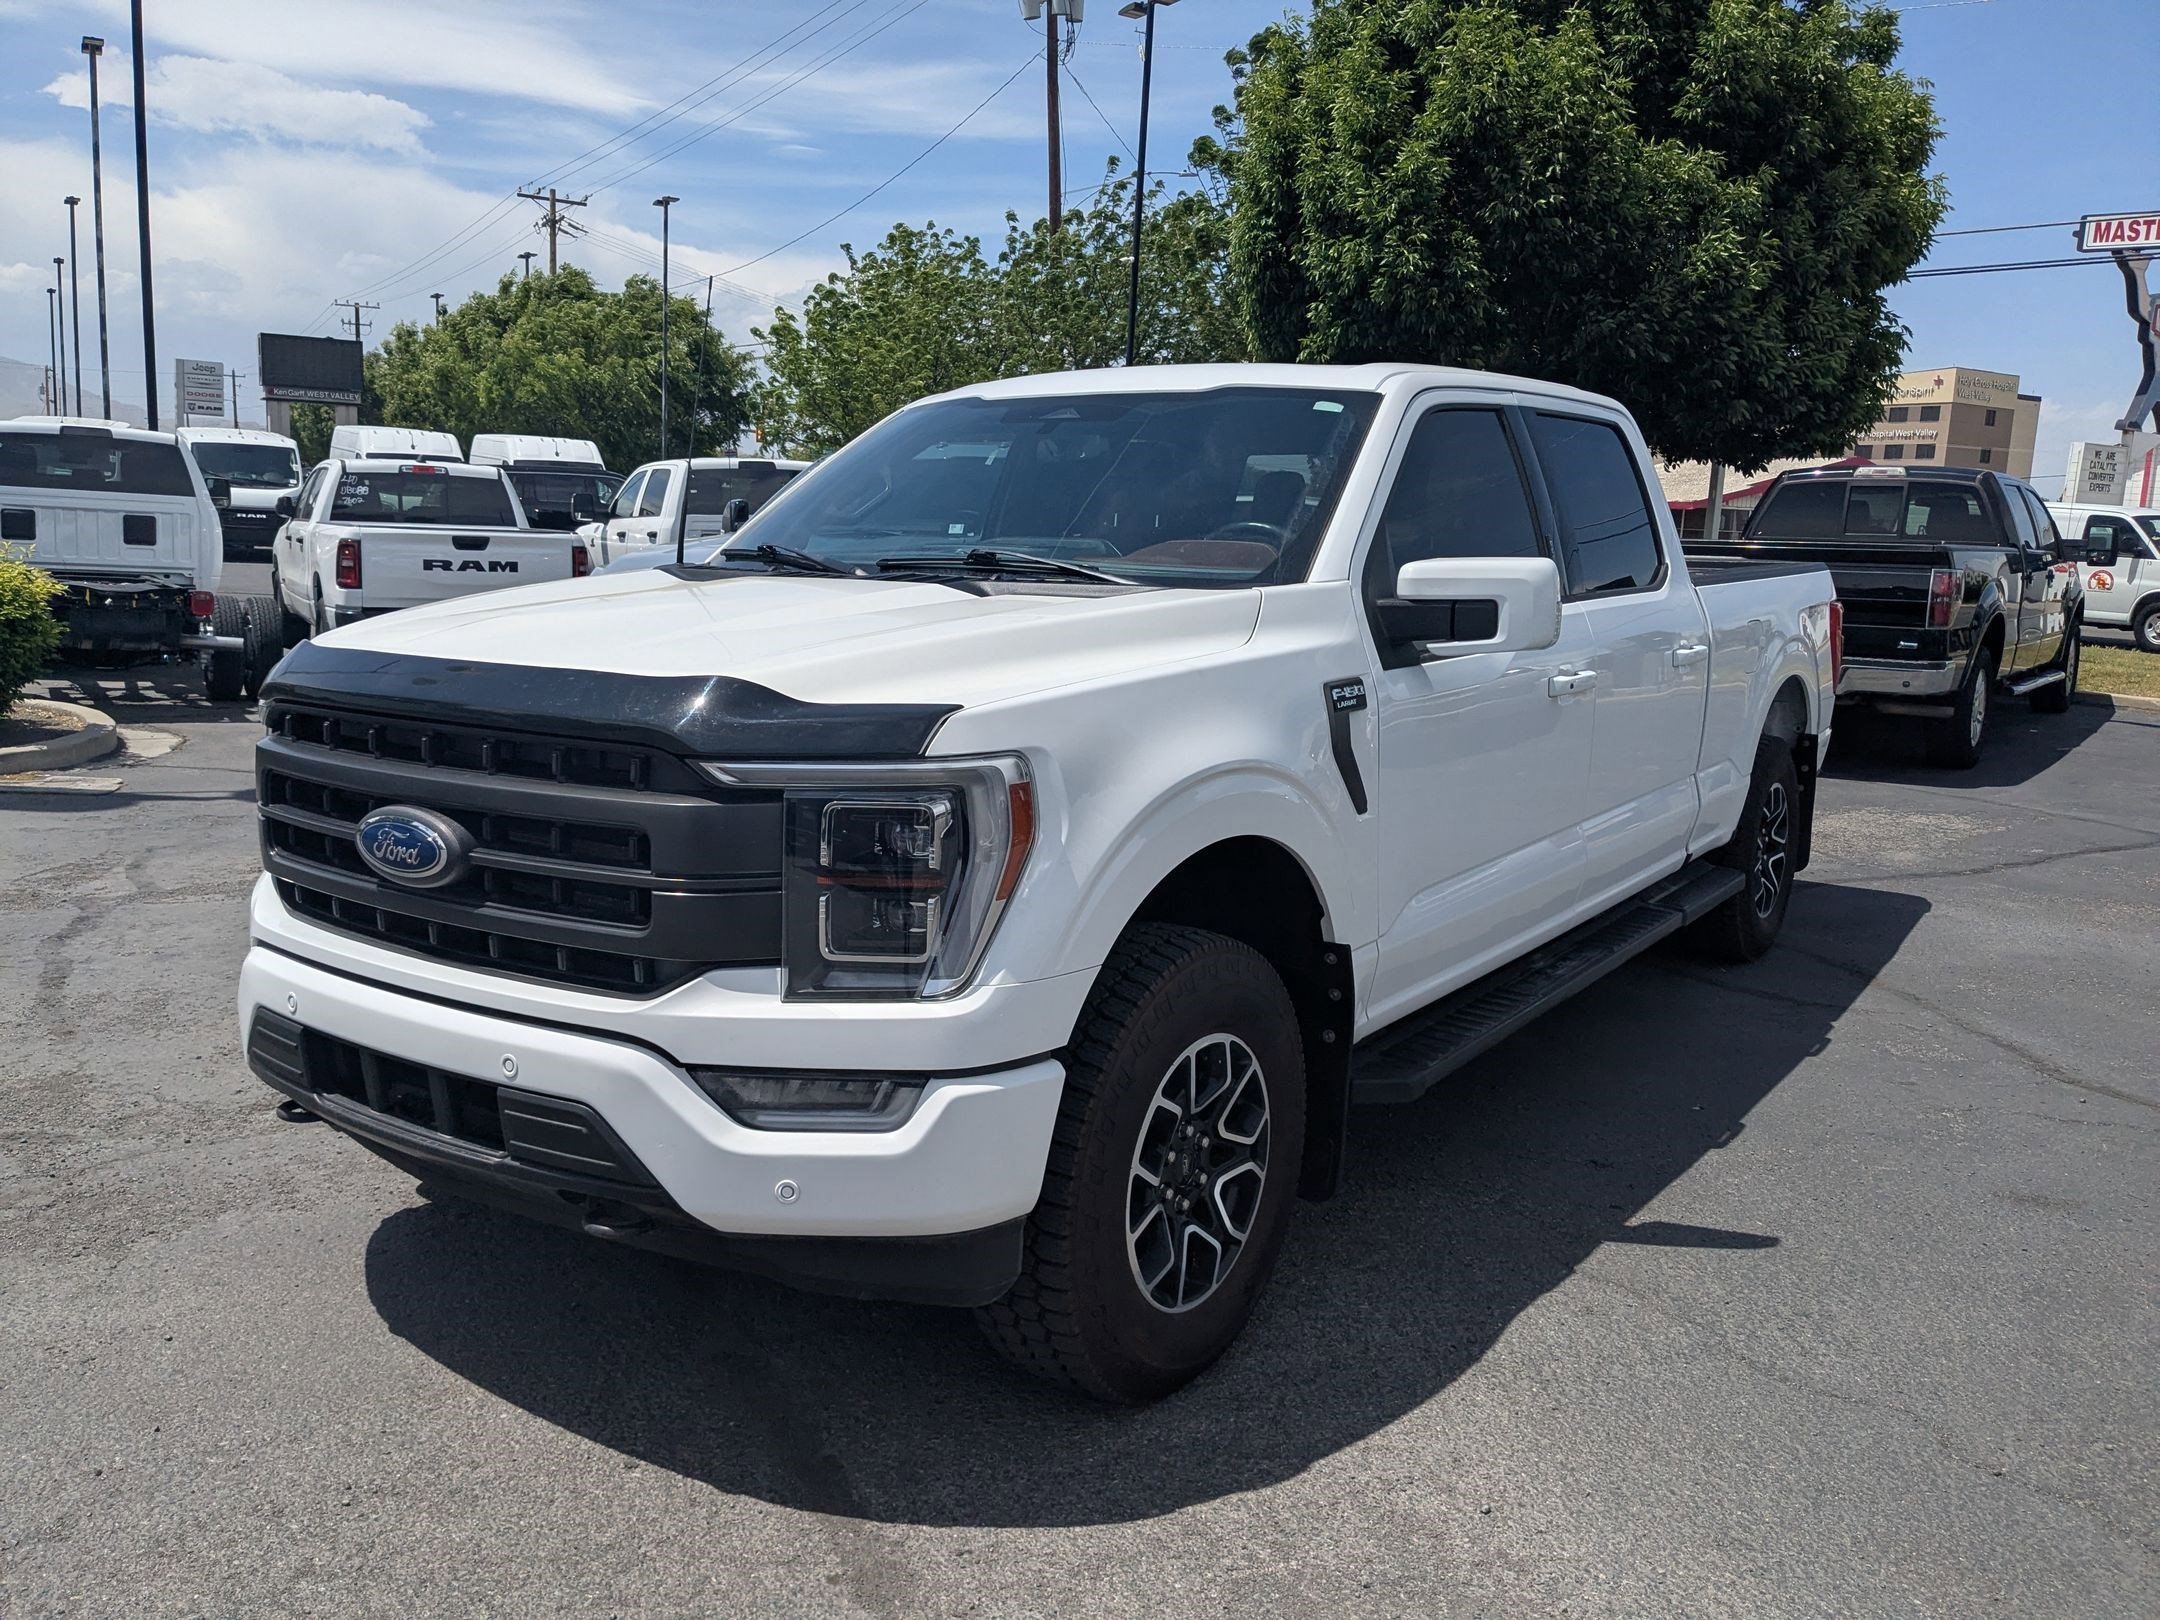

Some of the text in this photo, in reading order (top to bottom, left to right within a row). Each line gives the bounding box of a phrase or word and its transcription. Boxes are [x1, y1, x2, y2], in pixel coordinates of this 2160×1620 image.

[192, 363, 216, 373] Jeep
[273, 388, 360, 401] Ken Garff WEST VALLEY
[2095, 450, 2116, 461] WE ARE
[2089, 460, 2117, 472] CATALYTIC
[2088, 471, 2115, 482] CONVERTER
[2089, 482, 2111, 493] EXPERTS
[423, 559, 519, 572] RAM
[1332, 685, 1365, 700] F-150
[1337, 699, 1357, 709] LARIAT
[373, 826, 421, 865] Ford
